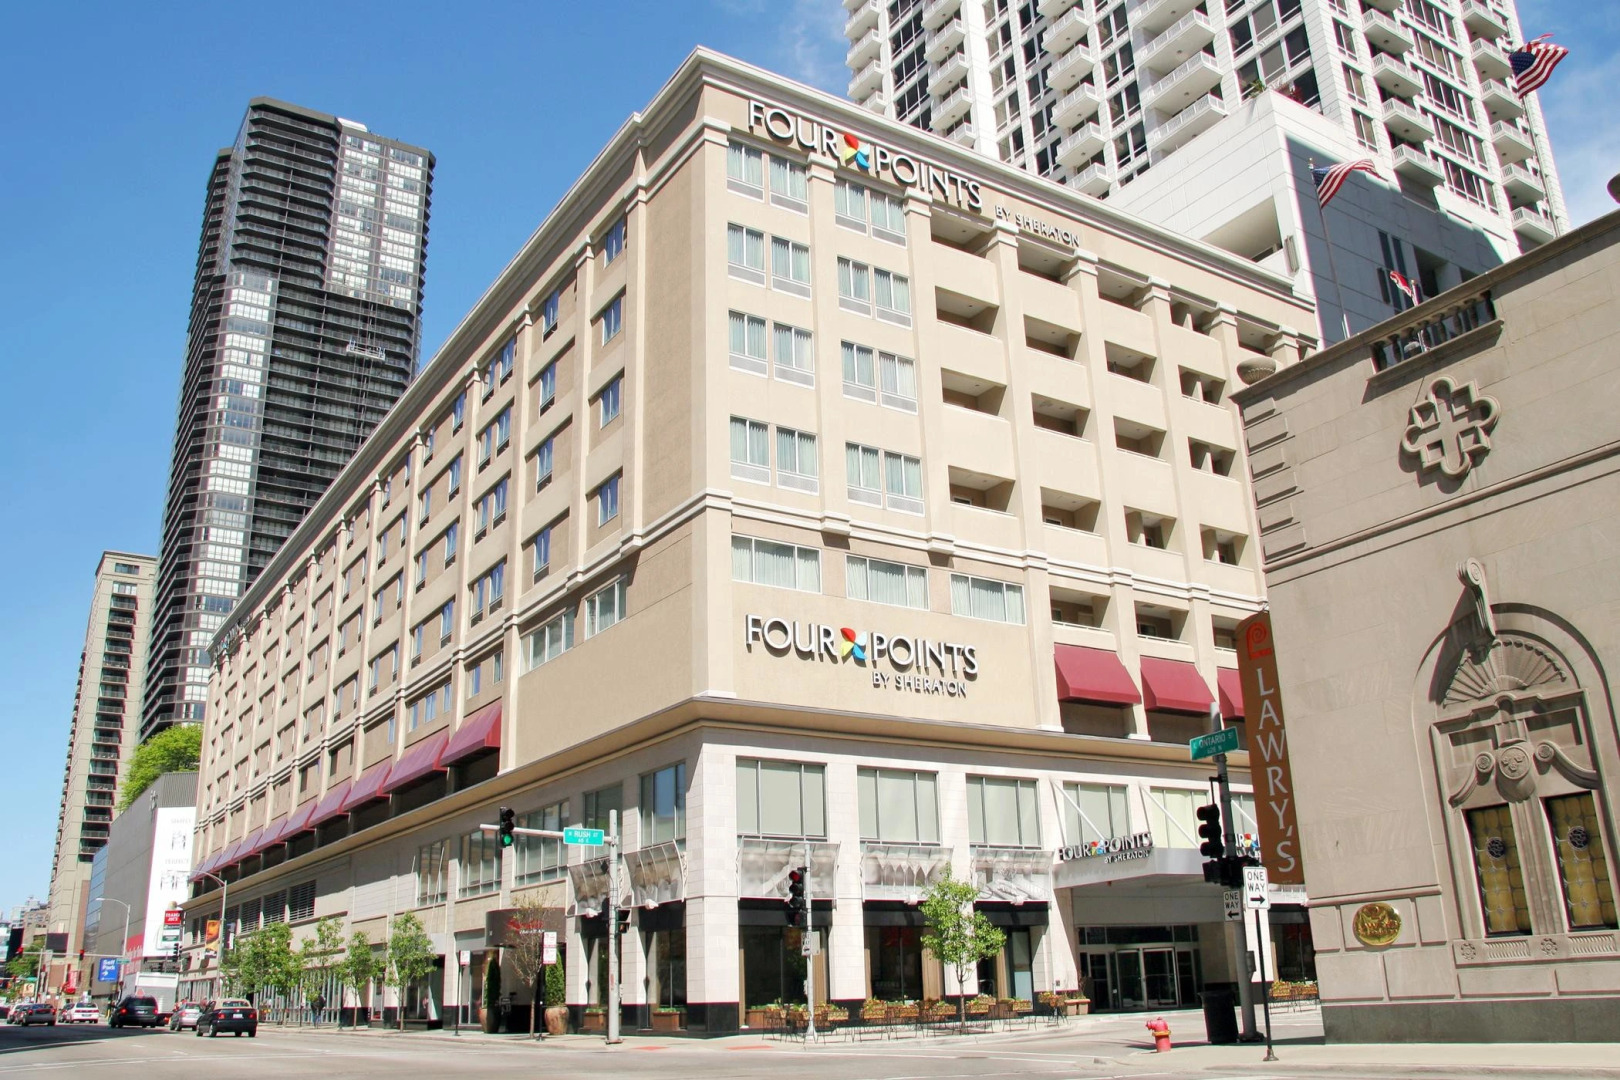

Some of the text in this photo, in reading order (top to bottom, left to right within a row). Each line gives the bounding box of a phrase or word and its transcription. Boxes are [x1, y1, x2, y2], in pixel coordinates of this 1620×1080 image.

[748, 99, 1081, 248] FOUR POINTS BY SHERATON
[745, 614, 979, 677] FOUR POINTS
[872, 671, 968, 698] BY SHERATON
[1198, 733, 1226, 748] ONTARIO
[1256, 667, 1296, 873] LAWRY'S
[574, 830, 591, 838] RUSH
[1058, 832, 1153, 861] FOUR POINTS
[1114, 850, 1149, 862] SHERATON
[1247, 871, 1265, 881] ONE
[1247, 883, 1266, 892] WAY
[1224, 892, 1239, 900] ONE
[1225, 901, 1239, 909] WAY
